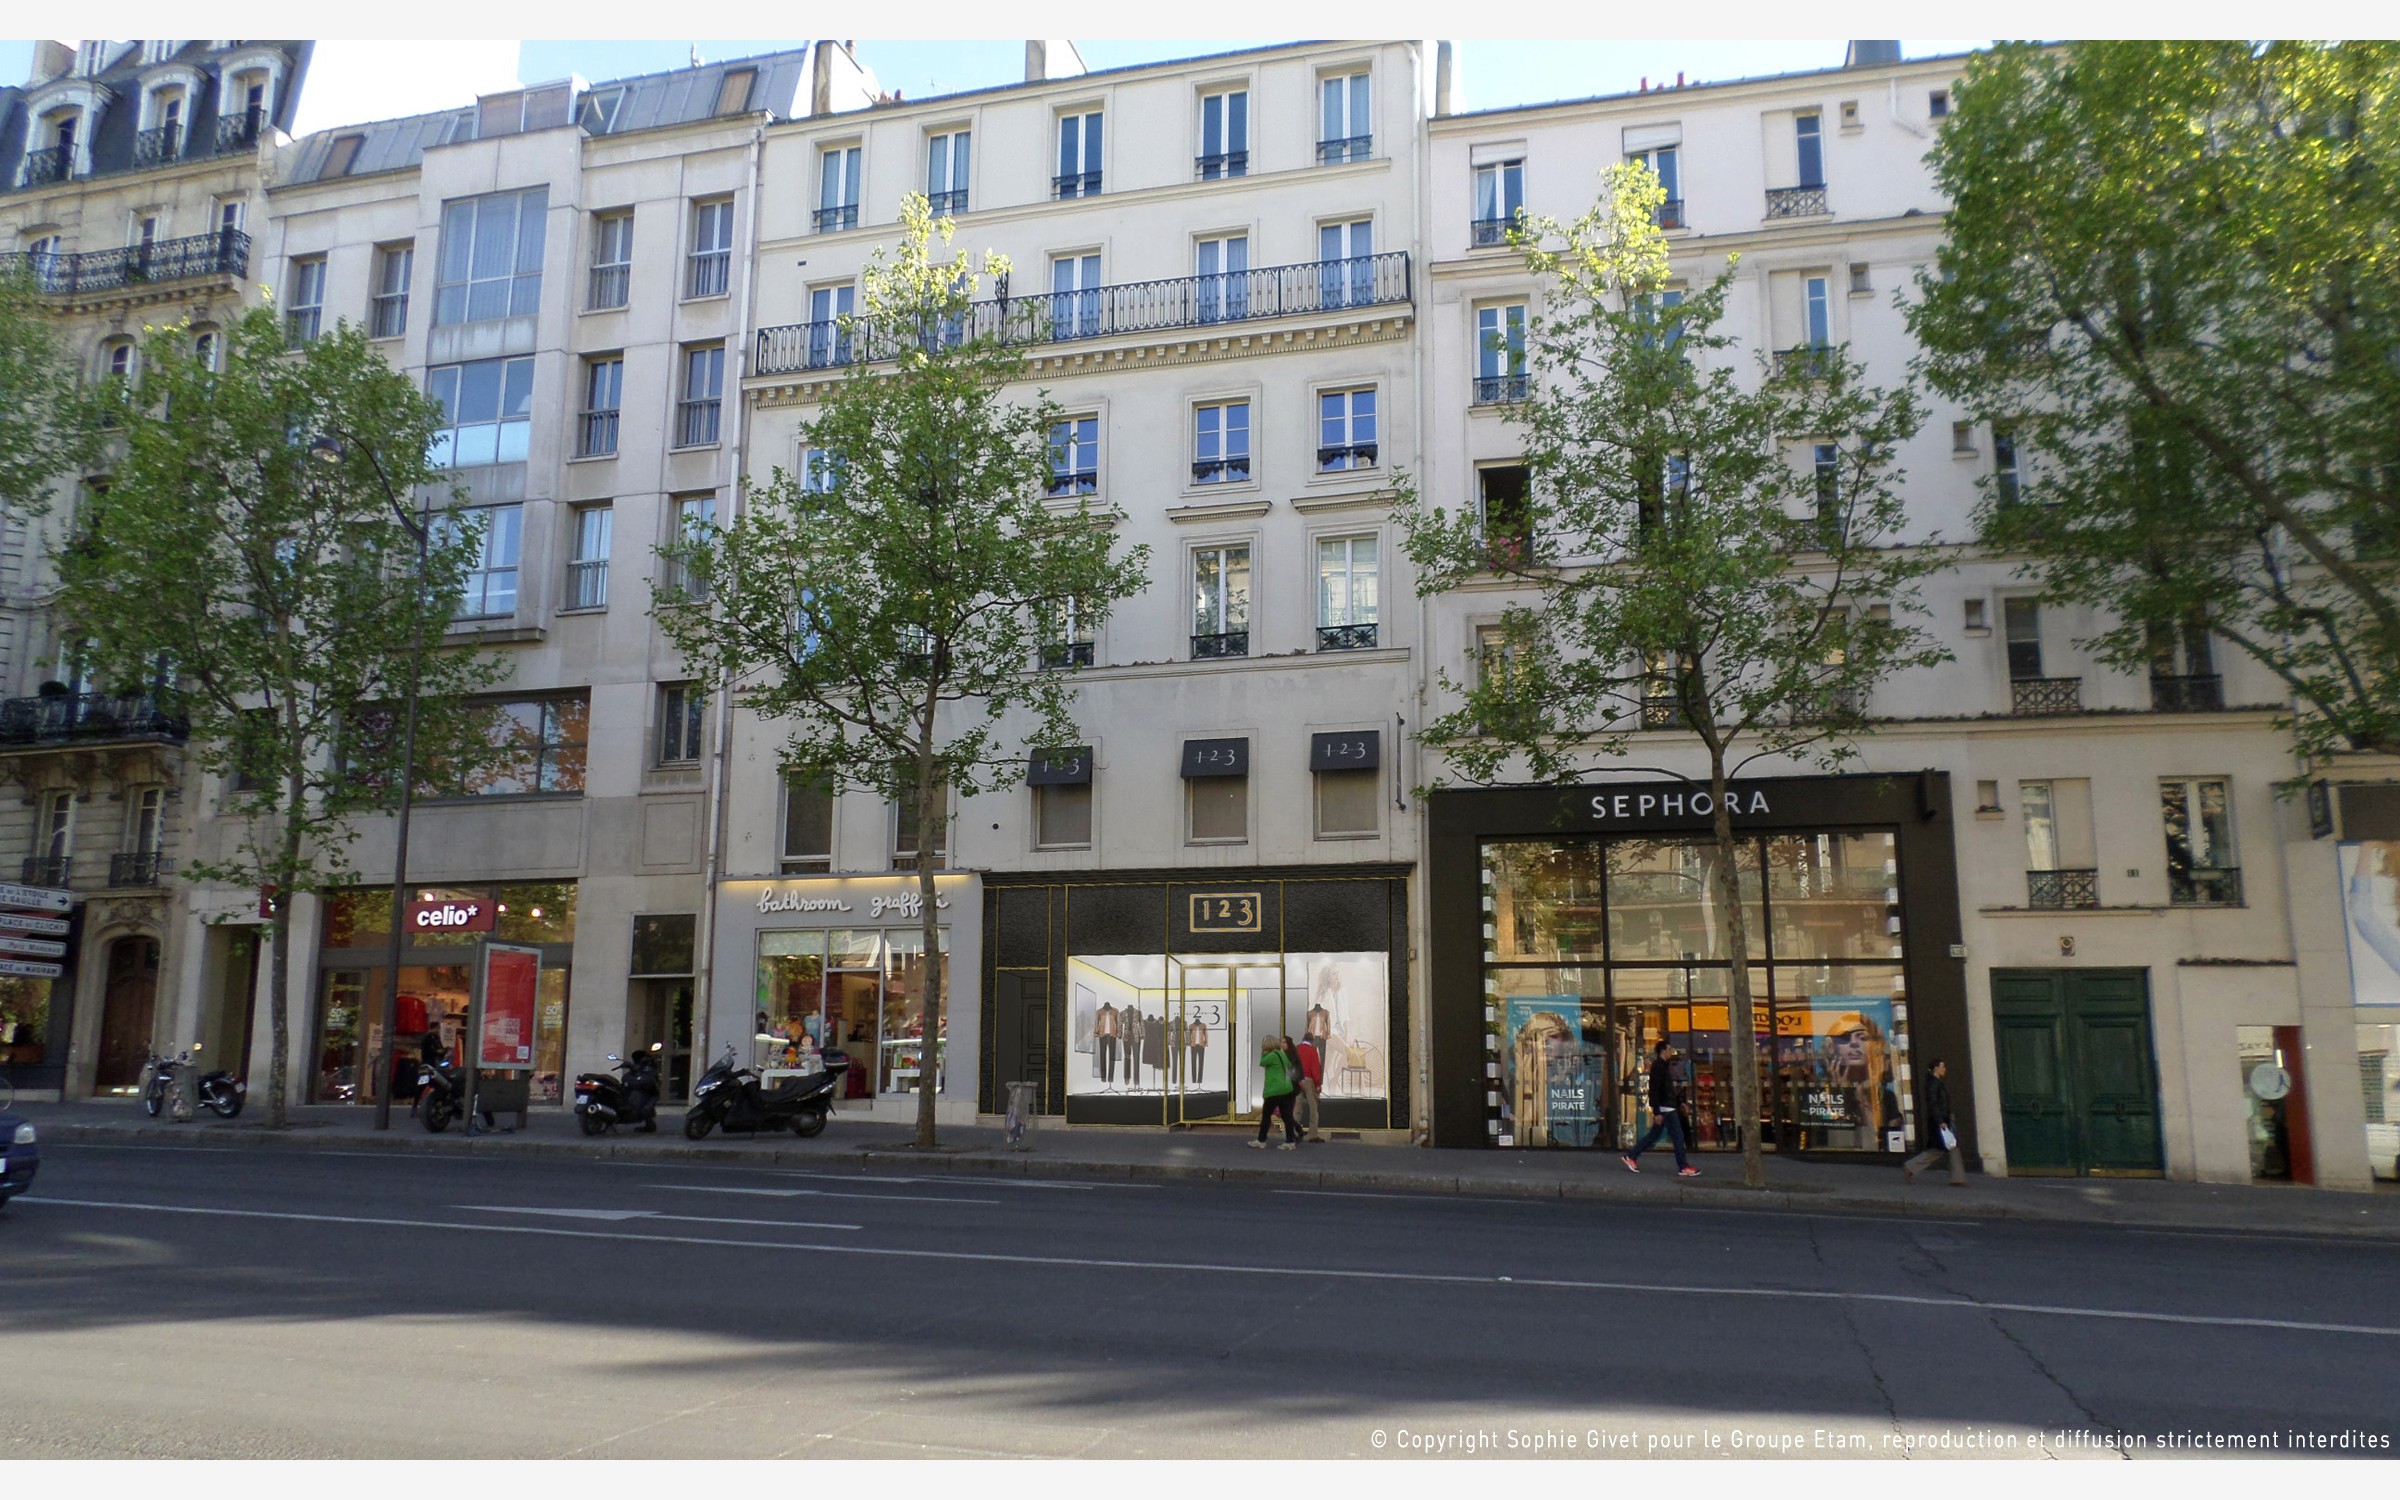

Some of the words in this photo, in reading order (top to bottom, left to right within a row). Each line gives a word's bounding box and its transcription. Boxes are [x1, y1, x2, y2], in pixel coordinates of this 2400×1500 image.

[1591, 790, 1771, 819] SEPHORA
[756, 886, 852, 914] bathroom
[1551, 1088, 1585, 1100] NAILS
[1808, 1093, 1846, 1105] NAILS
[1551, 1101, 1586, 1111] PIRATE
[1809, 1106, 1846, 1117] PIRATE
